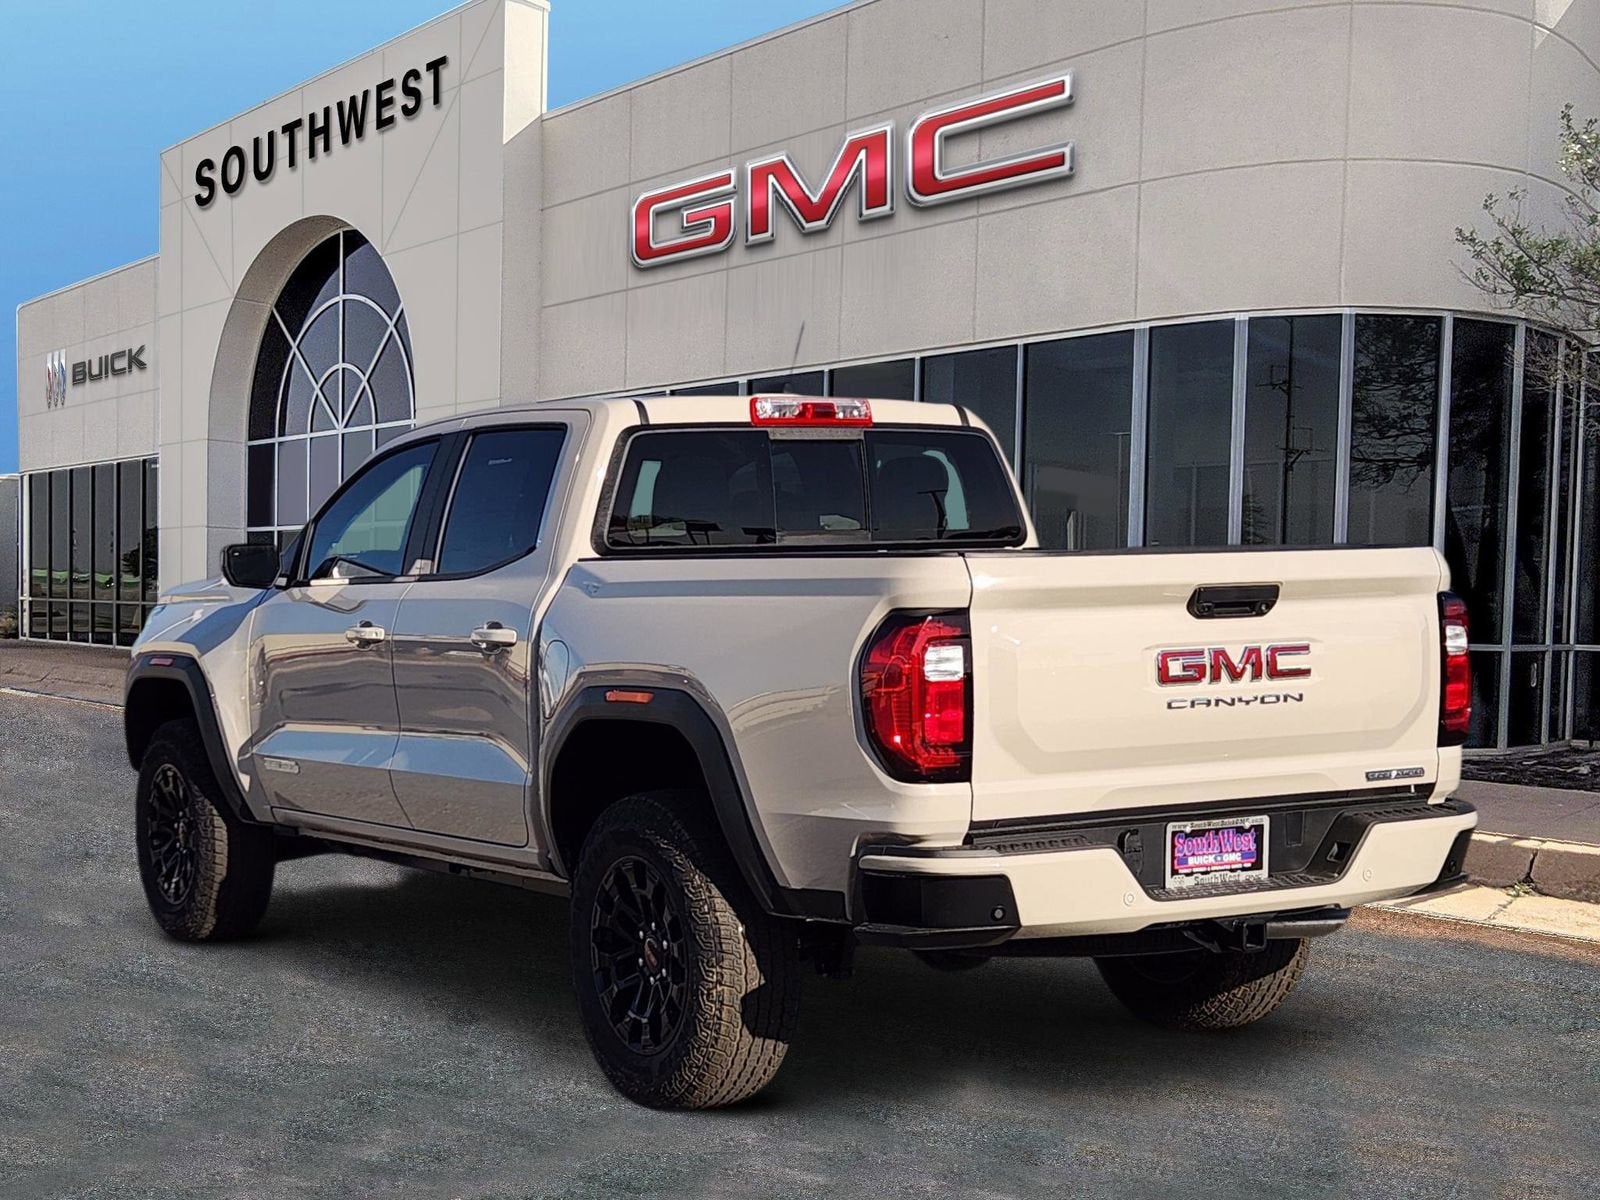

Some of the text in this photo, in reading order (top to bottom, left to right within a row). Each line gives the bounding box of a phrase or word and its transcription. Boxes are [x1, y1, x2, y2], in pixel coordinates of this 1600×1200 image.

[194, 56, 448, 206] SOUTHWEST
[630, 69, 1075, 269] GMC
[72, 344, 147, 387] BUICK
[1156, 642, 1311, 686] GMC
[1166, 692, 1304, 711] CANYON
[1188, 852, 1242, 866] BUICK GMC
